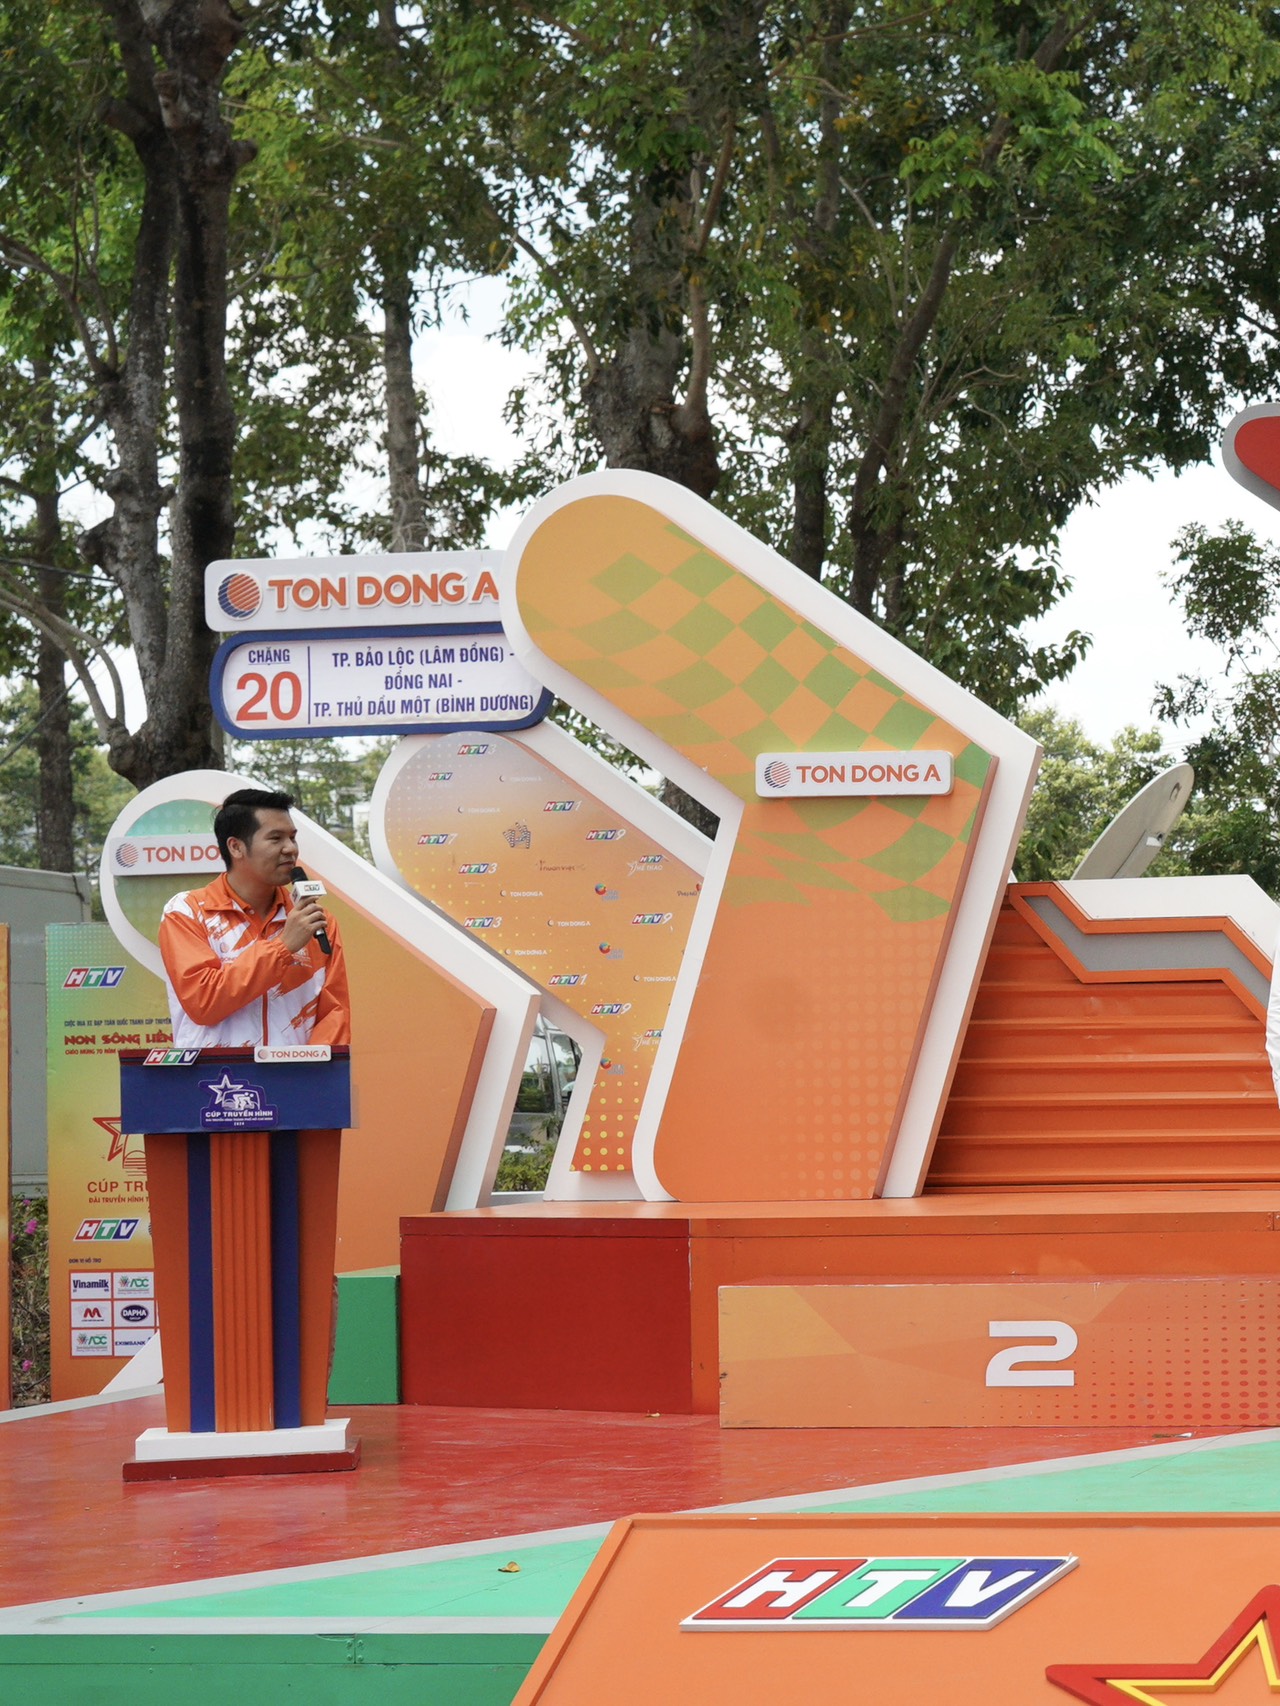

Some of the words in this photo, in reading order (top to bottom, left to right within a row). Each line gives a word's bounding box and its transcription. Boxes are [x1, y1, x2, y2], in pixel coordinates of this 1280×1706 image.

[268, 577, 346, 609] TON
[358, 574, 466, 605] DONG
[472, 572, 499, 601] A
[249, 649, 290, 665] CHẶNG
[333, 653, 351, 667] TP.
[356, 646, 384, 666] BẢO
[389, 647, 414, 669] LỘC
[420, 646, 455, 666] (LÂM
[459, 643, 504, 664] ĐỒNG)
[385, 671, 423, 690] ĐỒNG
[429, 674, 452, 688] NAI
[236, 671, 301, 721] 20
[314, 703, 333, 717] TP.
[337, 697, 363, 716] THỦ
[368, 695, 395, 715] DẦU
[400, 698, 430, 719] MỘT
[436, 695, 476, 714] (BÌNH
[480, 694, 534, 713] DƯƠNG)
[796, 765, 845, 783] TON
[852, 765, 920, 783] DONG
[924, 765, 941, 782] A
[143, 847, 186, 863] TON
[65, 968, 123, 986] HTV
[65, 1034, 96, 1046] NON
[102, 1032, 141, 1046] SÔNG
[147, 1050, 199, 1063] HTV
[88, 1178, 119, 1193] CÚP
[77, 1221, 138, 1238] HTV
[73, 1279, 109, 1289] Vinamilk
[985, 1320, 1078, 1387] 2
[703, 1564, 1050, 1612] HTV
